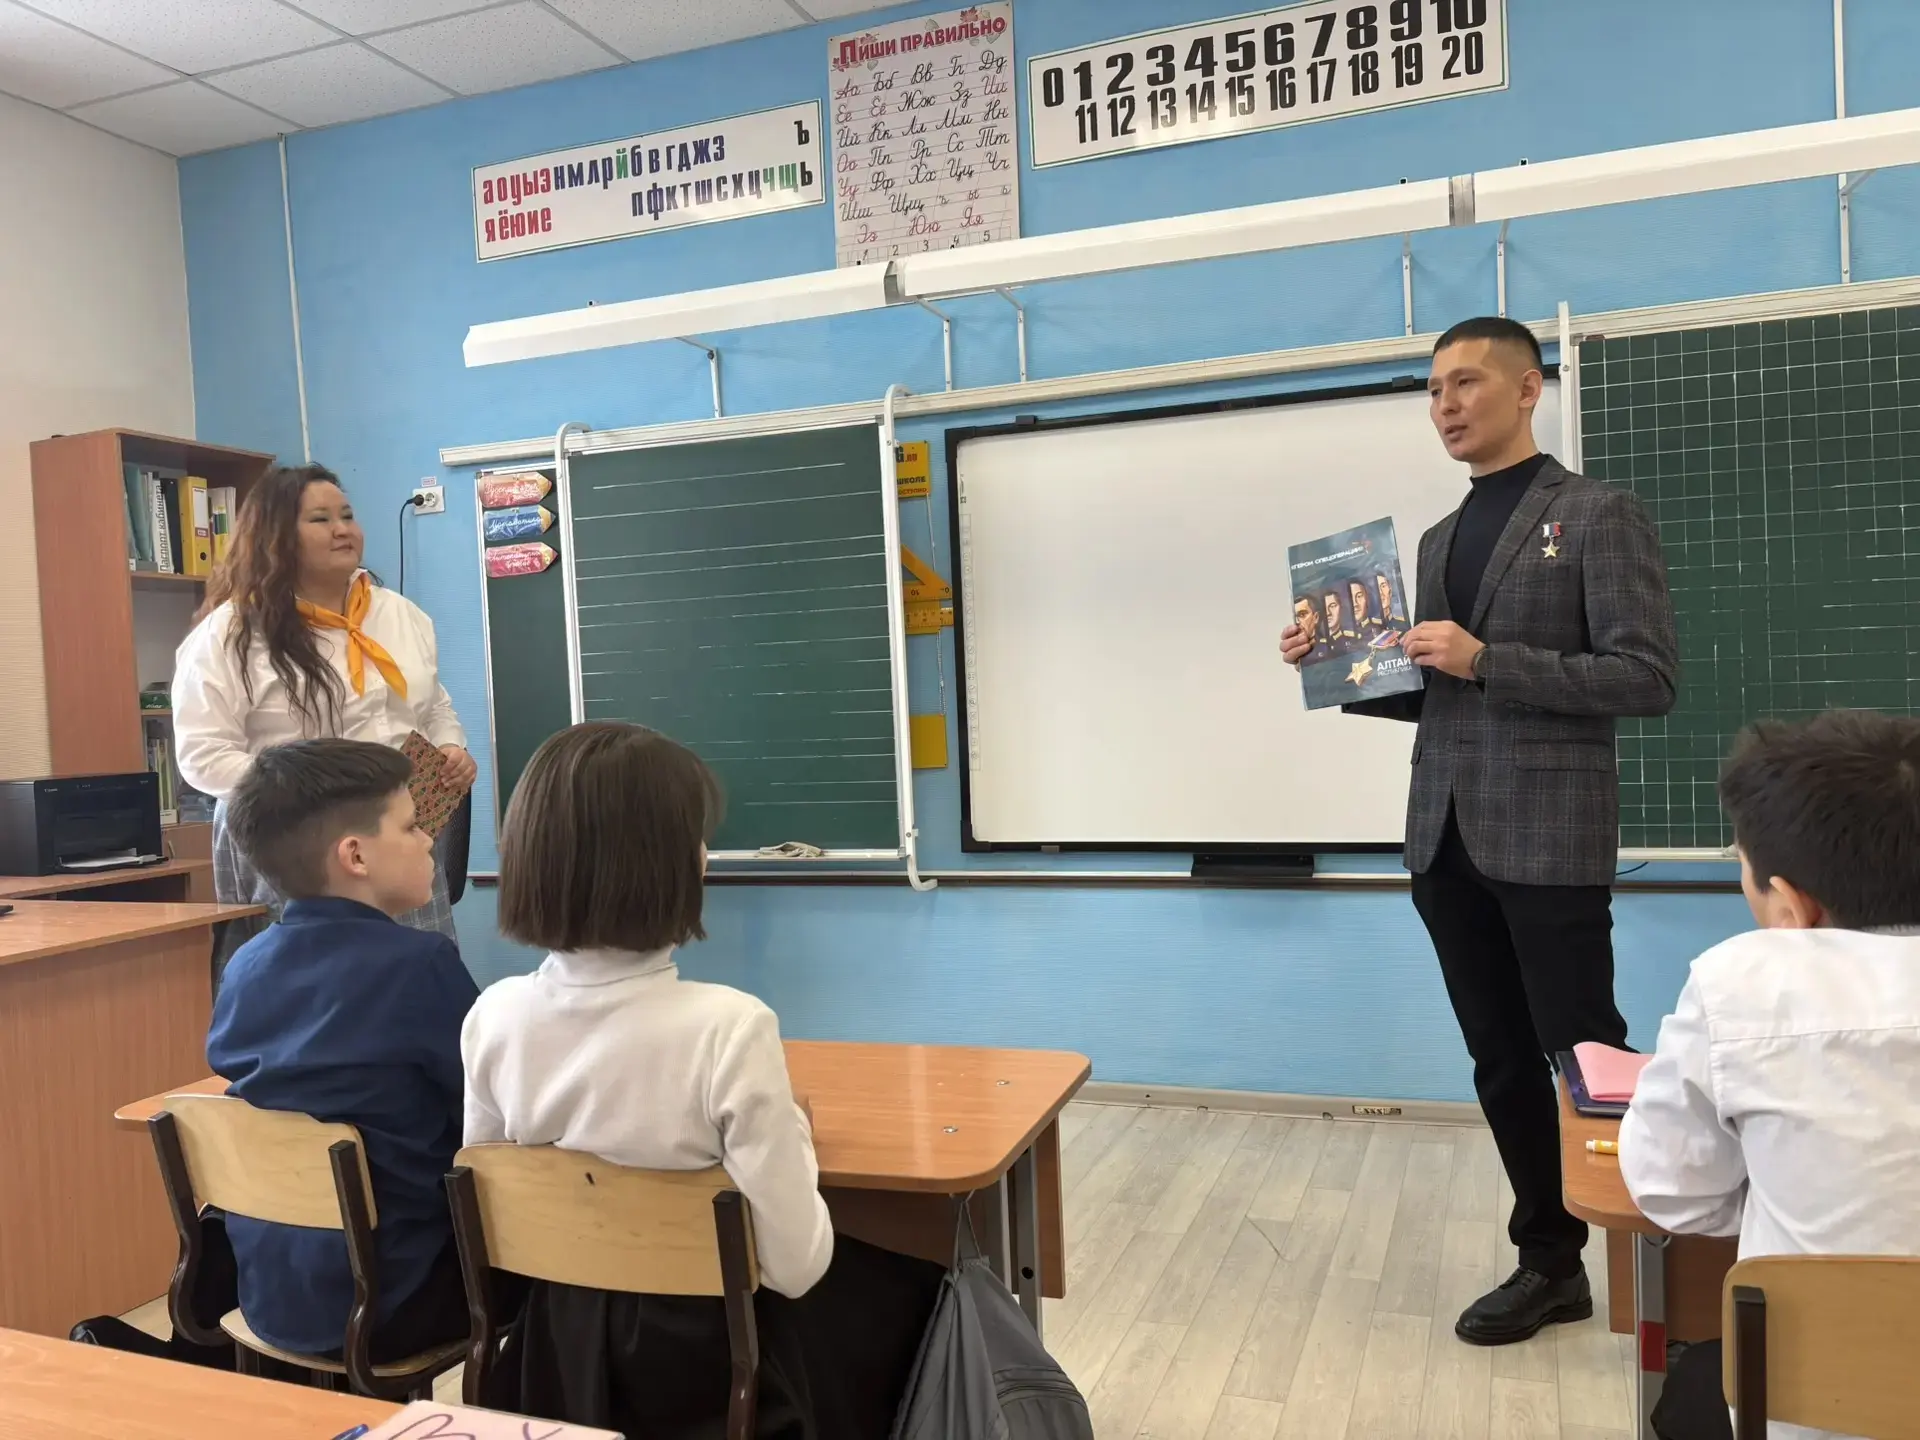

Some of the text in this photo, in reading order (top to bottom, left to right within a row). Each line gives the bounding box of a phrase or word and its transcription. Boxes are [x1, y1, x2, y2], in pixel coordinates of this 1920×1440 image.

[900, 17, 1008, 53] ПРАВИЛЬНО
[1042, 0, 1487, 107] 0 1 2 3 4 5 6 7 8 9 10
[835, 50, 1007, 100] Аа Бб Вв Гг Дд
[1074, 31, 1485, 144] 11 12 13 14 15 16 17 18 19 20
[836, 75, 1008, 124] Ее Ёё Жж Зз Ии
[836, 99, 1009, 148] Йй Кк Лл Мм Нн
[837, 126, 1011, 173] Оо Пп Рр Сс Тт
[838, 151, 1010, 201] Уу Фф Хх Цц Чч
[839, 185, 1011, 222] Шш Щщ ъ ы ь
[857, 207, 984, 244] Ээ Юю Яя
[892, 245, 899, 256] 2
[983, 230, 990, 241] 5
[160, 531, 169, 571] Паспорт
[1377, 655, 1412, 671] АЛТАЙ
